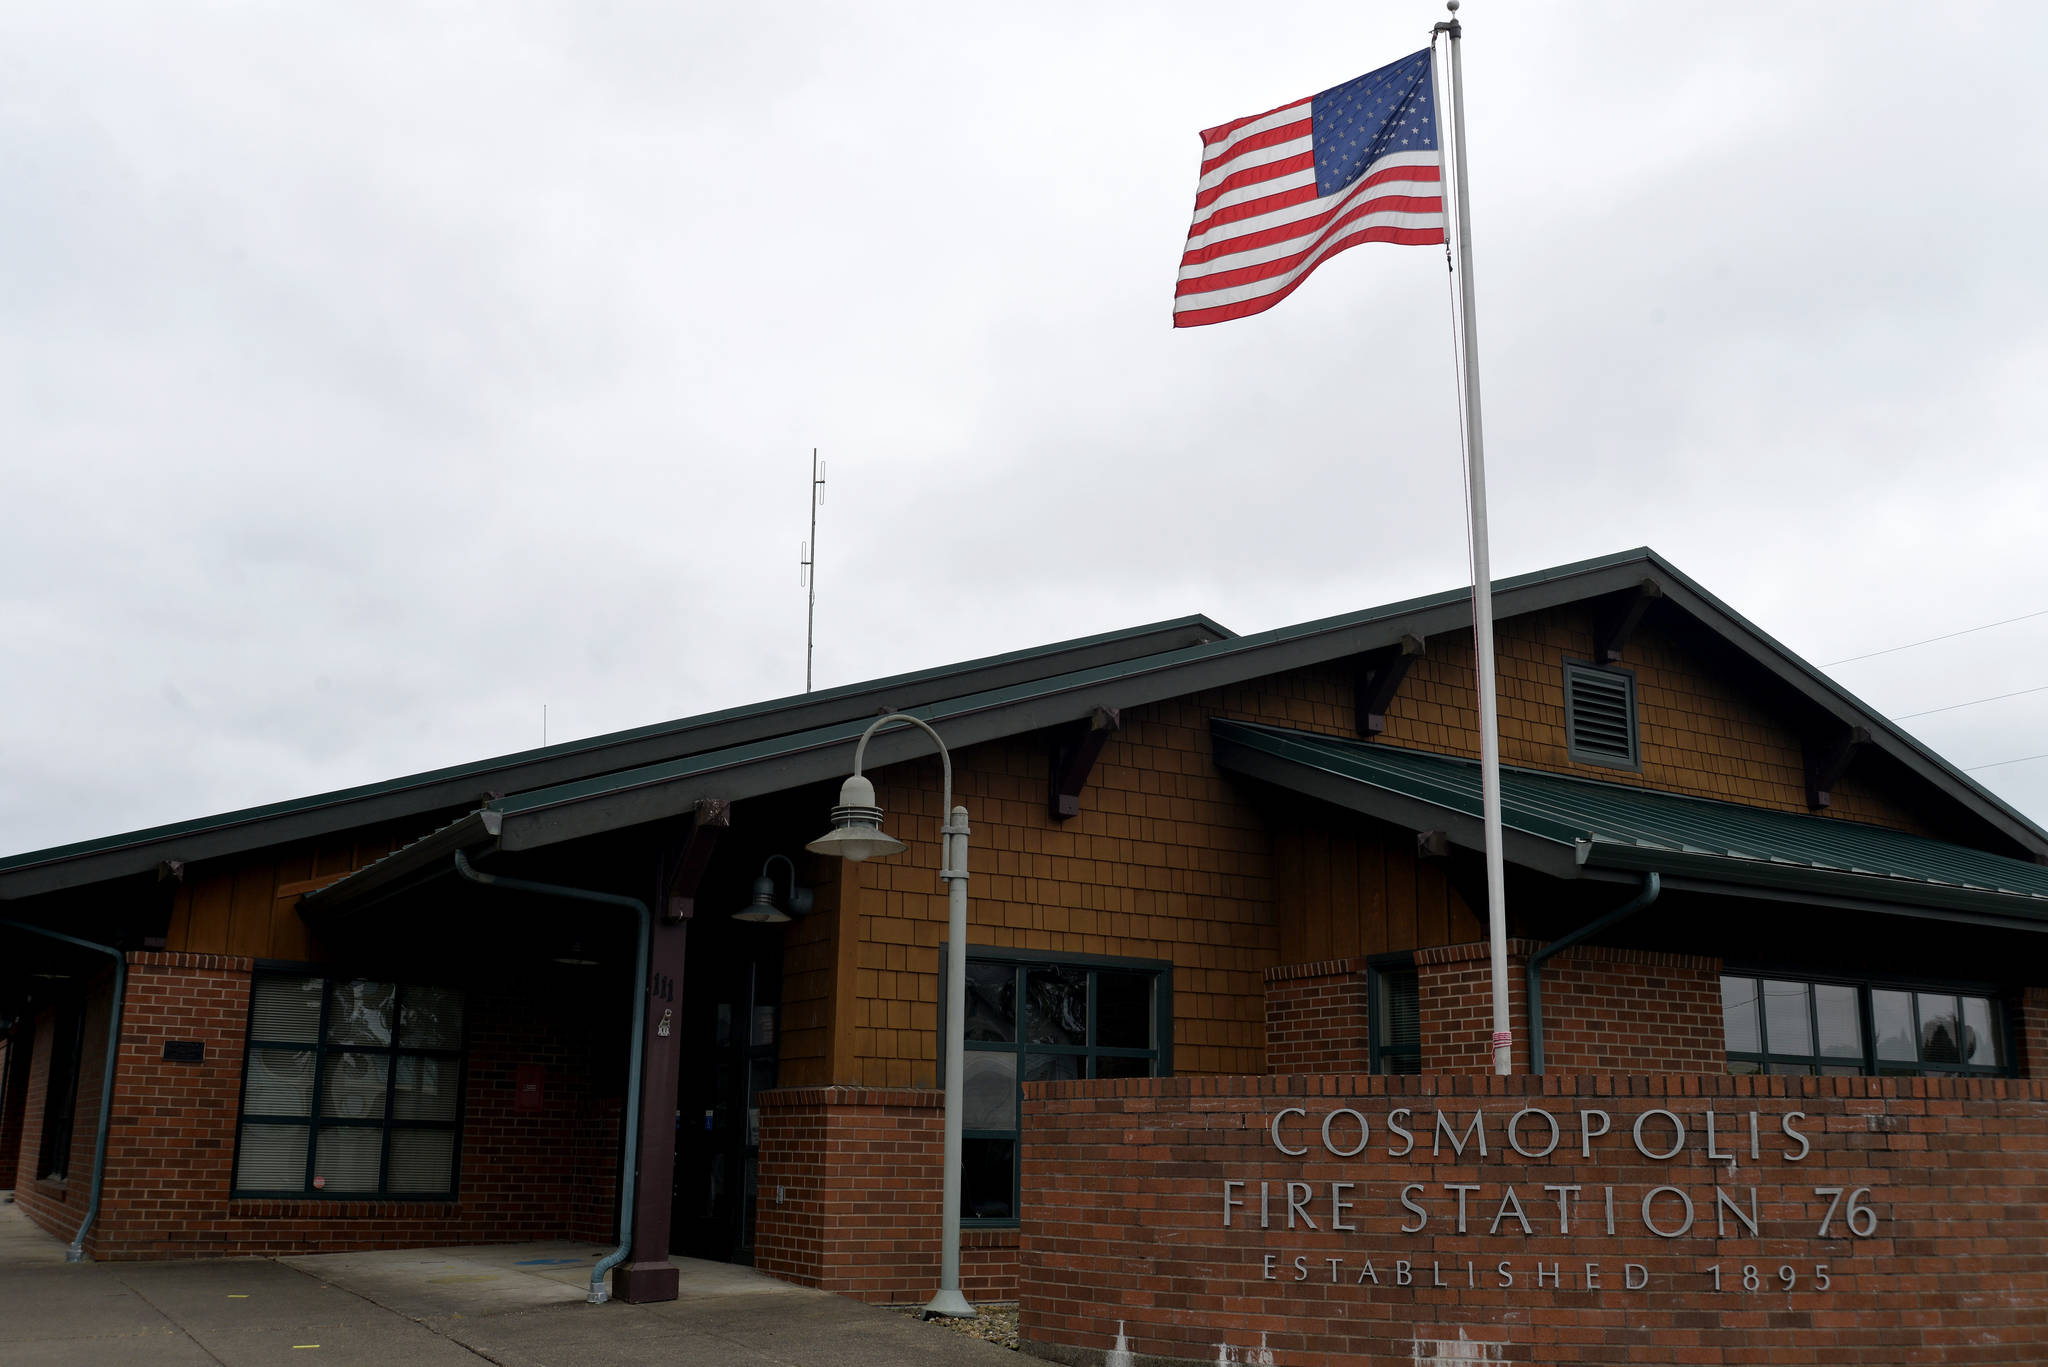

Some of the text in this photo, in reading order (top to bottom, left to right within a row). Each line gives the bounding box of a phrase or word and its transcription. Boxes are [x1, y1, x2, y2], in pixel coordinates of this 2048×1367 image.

[1271, 1107, 1809, 1161] COSMOPOLIS
[1223, 1180, 1877, 1238] FIRE STATION 76
[1264, 1255, 1830, 1290] ESTABLISHED 1895
